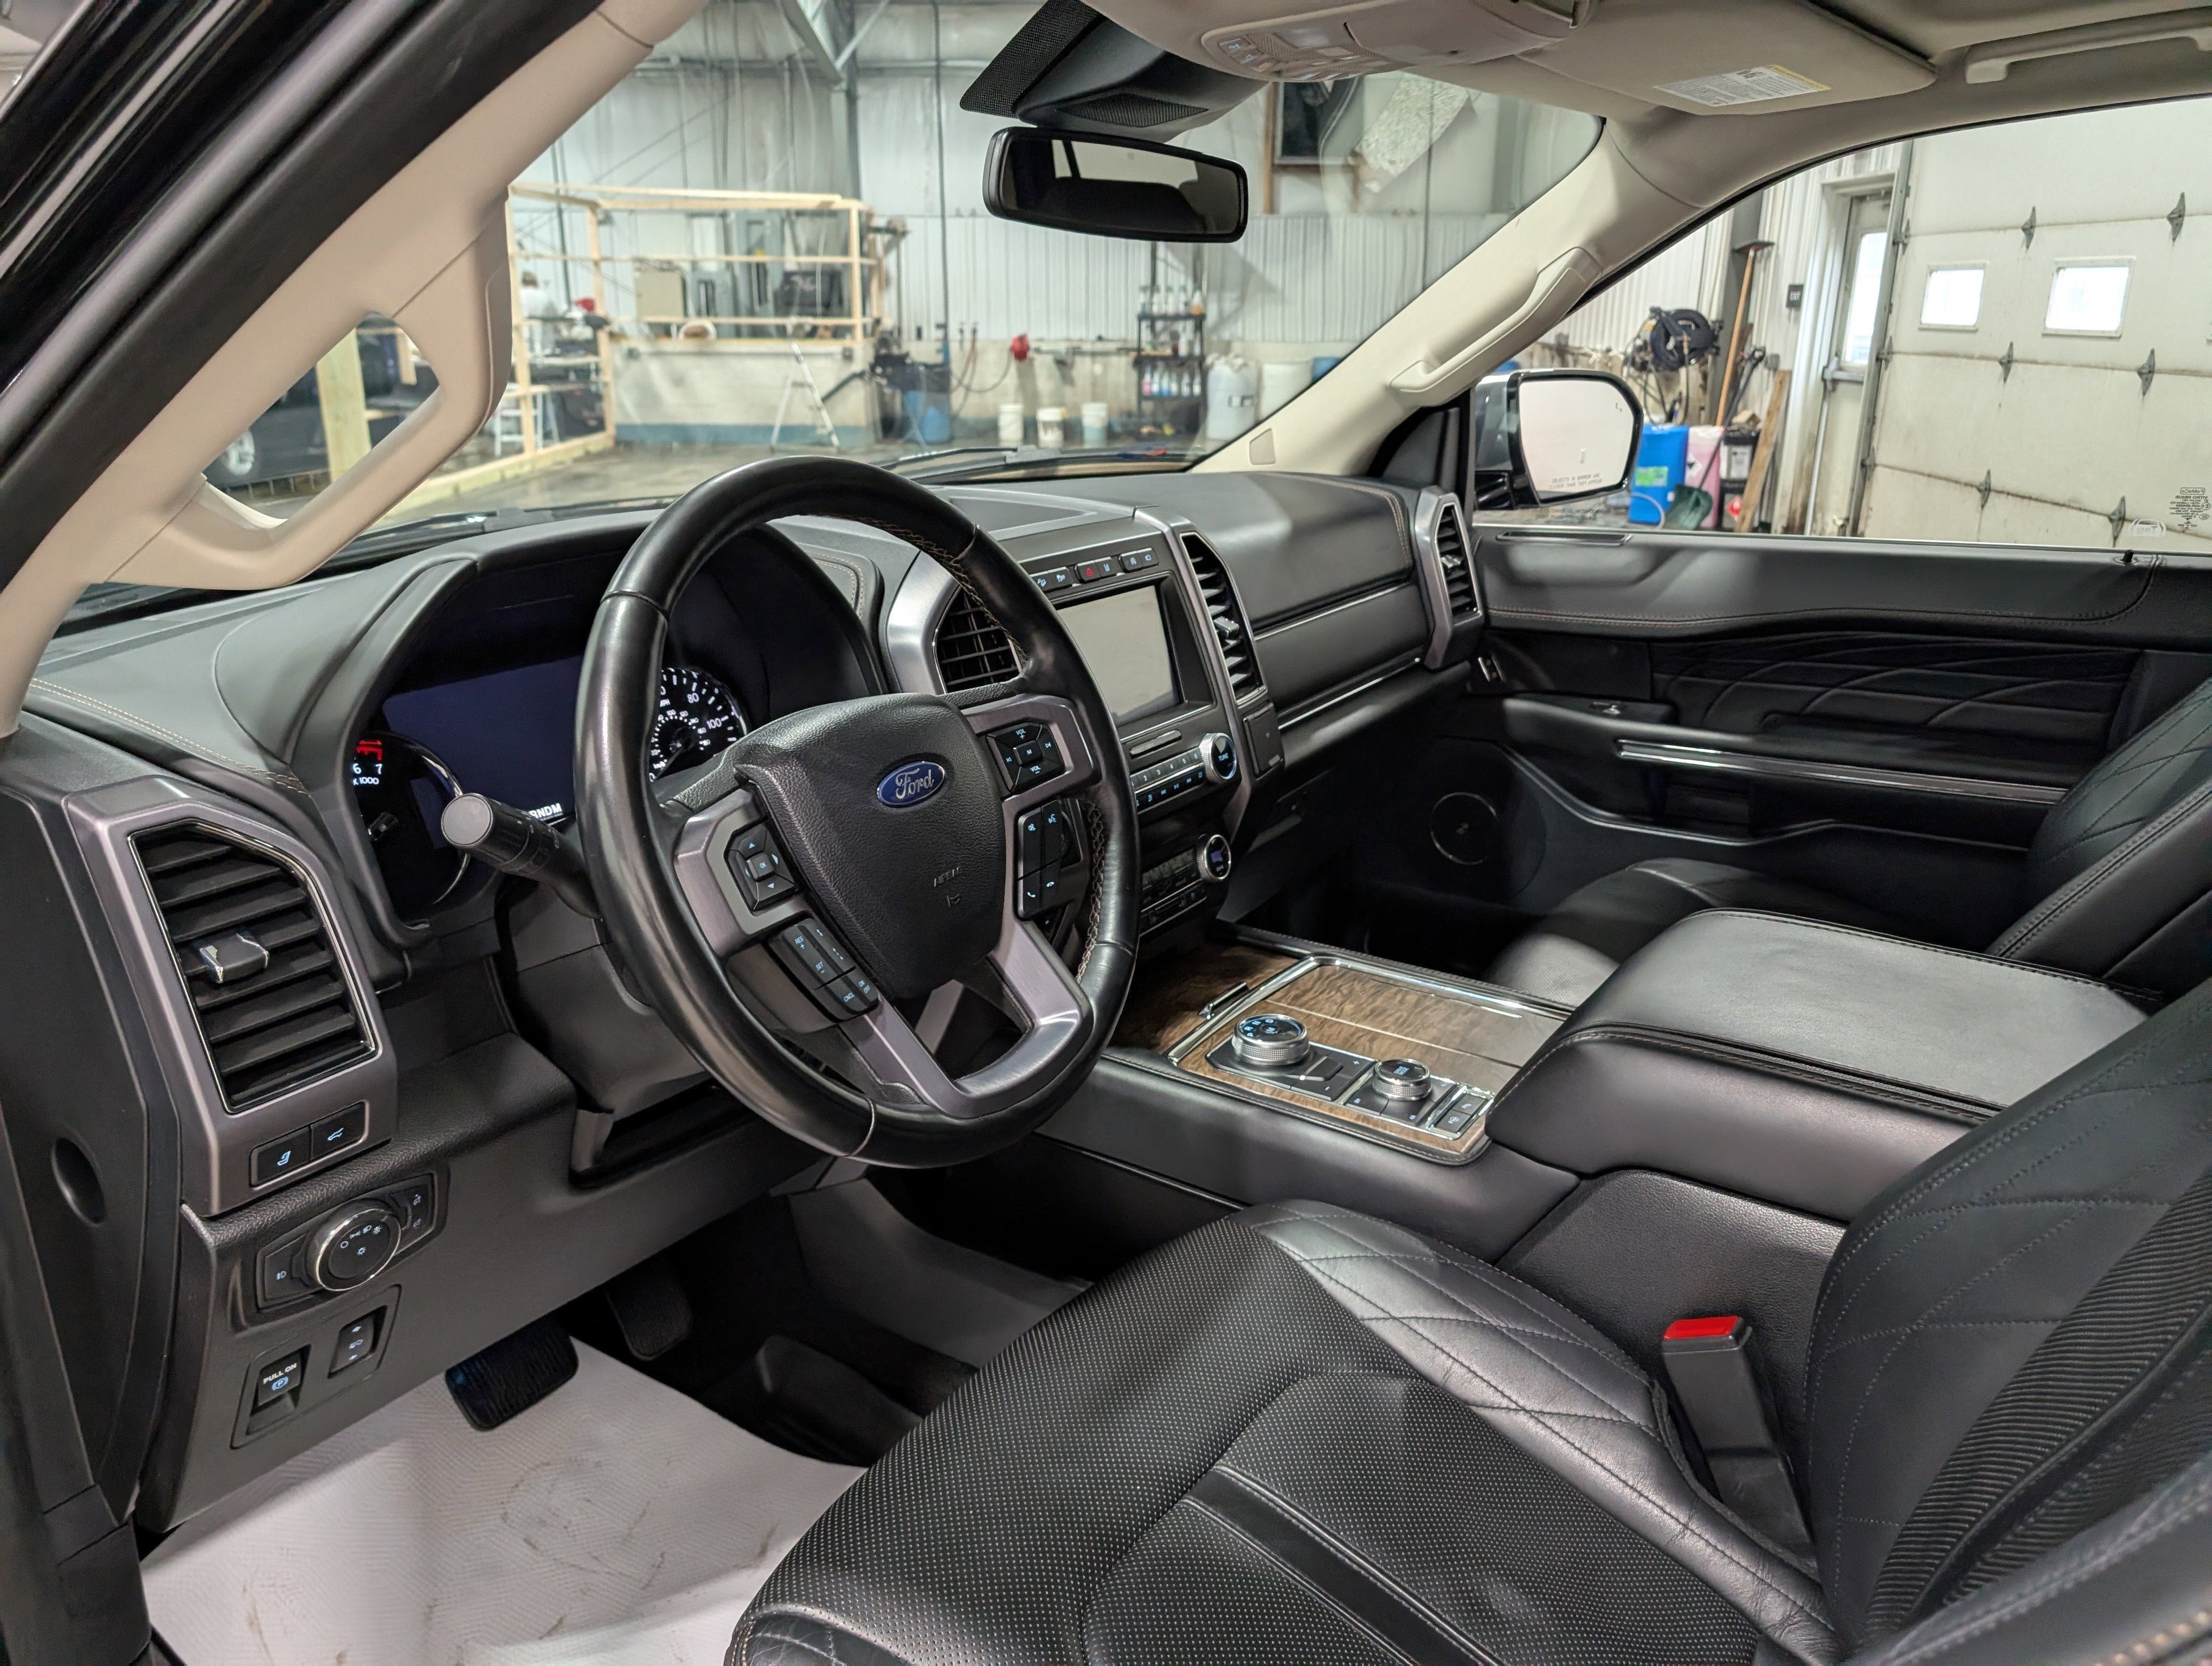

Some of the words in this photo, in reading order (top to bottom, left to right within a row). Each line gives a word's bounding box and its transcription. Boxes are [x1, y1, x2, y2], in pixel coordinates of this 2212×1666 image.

[687, 693, 699, 703] 80
[706, 717, 722, 729] 100
[352, 762, 362, 774] 6
[375, 763, 383, 775] 7
[359, 777, 380, 785] 1000
[895, 767, 934, 799] Ford
[263, 1370, 284, 1385] PULL
[285, 1362, 297, 1373] ON
